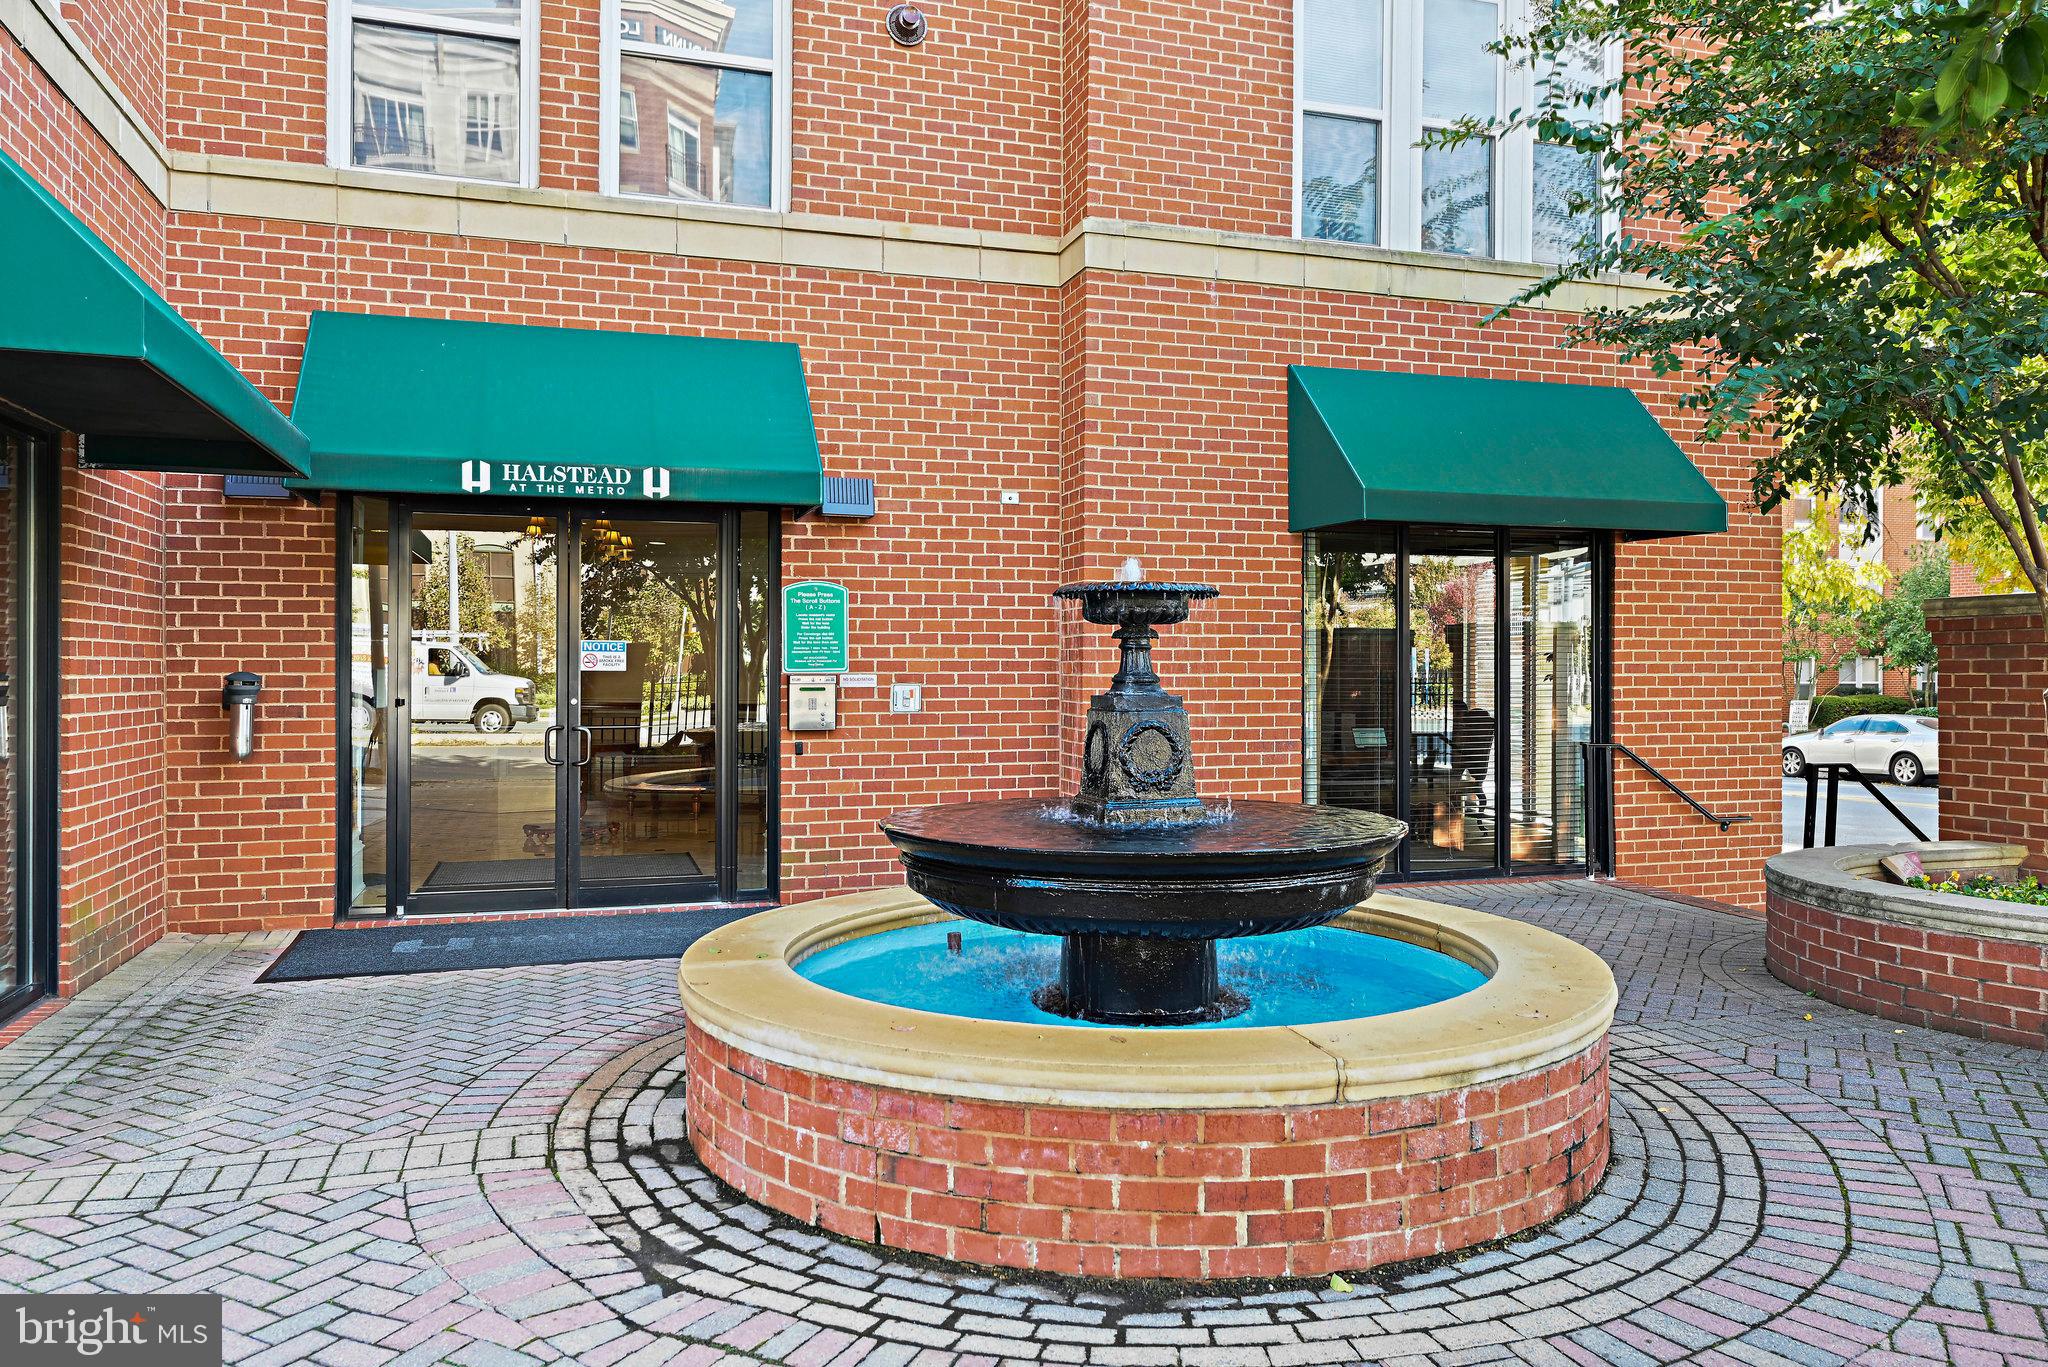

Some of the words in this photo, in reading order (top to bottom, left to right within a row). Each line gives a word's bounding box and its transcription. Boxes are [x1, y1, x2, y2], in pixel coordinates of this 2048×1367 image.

[502, 463, 632, 485] HALSTEAD
[509, 483, 527, 493] AT
[536, 484, 565, 494] THE
[575, 485, 626, 495] METRO
[584, 642, 623, 651] NOTICE
